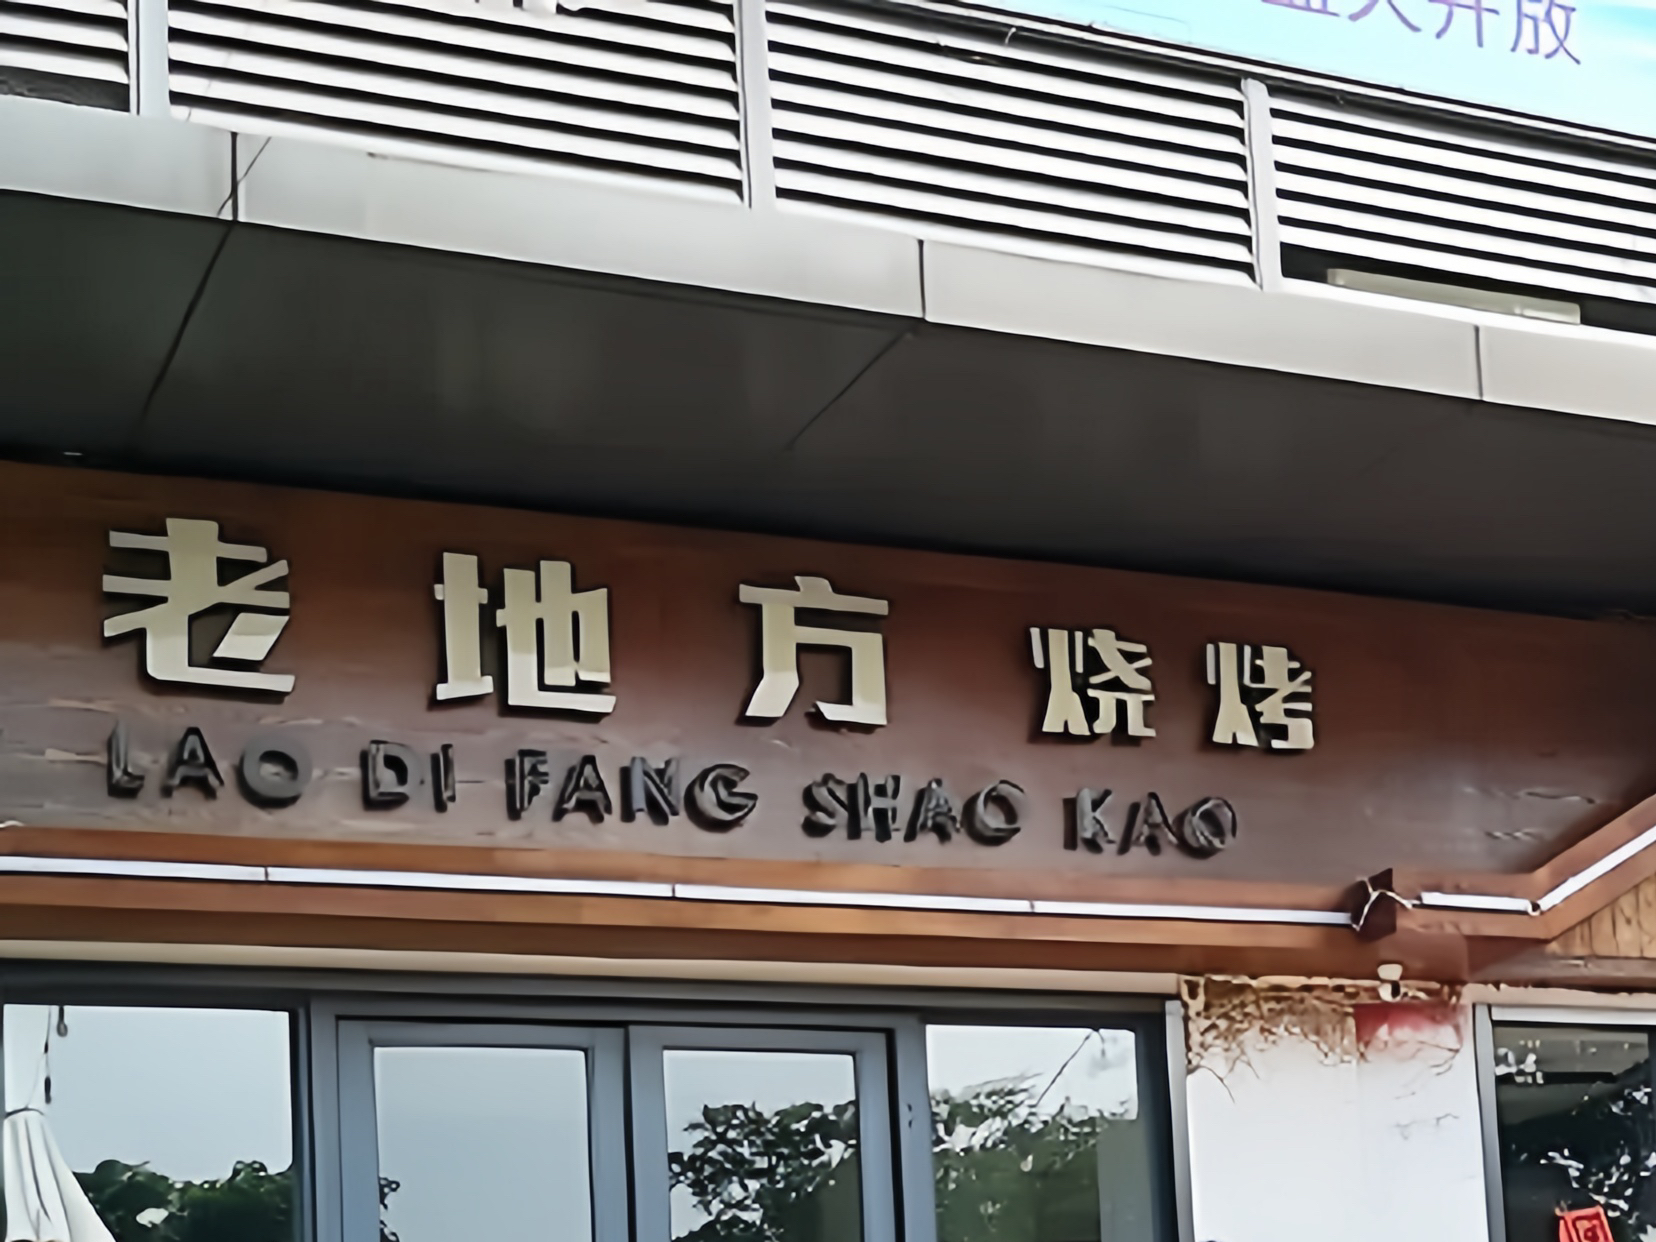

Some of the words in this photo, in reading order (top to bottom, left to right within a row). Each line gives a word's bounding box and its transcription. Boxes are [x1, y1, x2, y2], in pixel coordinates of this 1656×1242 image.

[1262, 0, 1581, 65] 开放
[102, 516, 1316, 750] 老地方烧烤
[106, 720, 312, 808] LAO
[360, 738, 457, 814] DI
[504, 748, 760, 832] FANG
[801, 771, 1025, 847] SHAO
[1062, 786, 1237, 858] KAO
